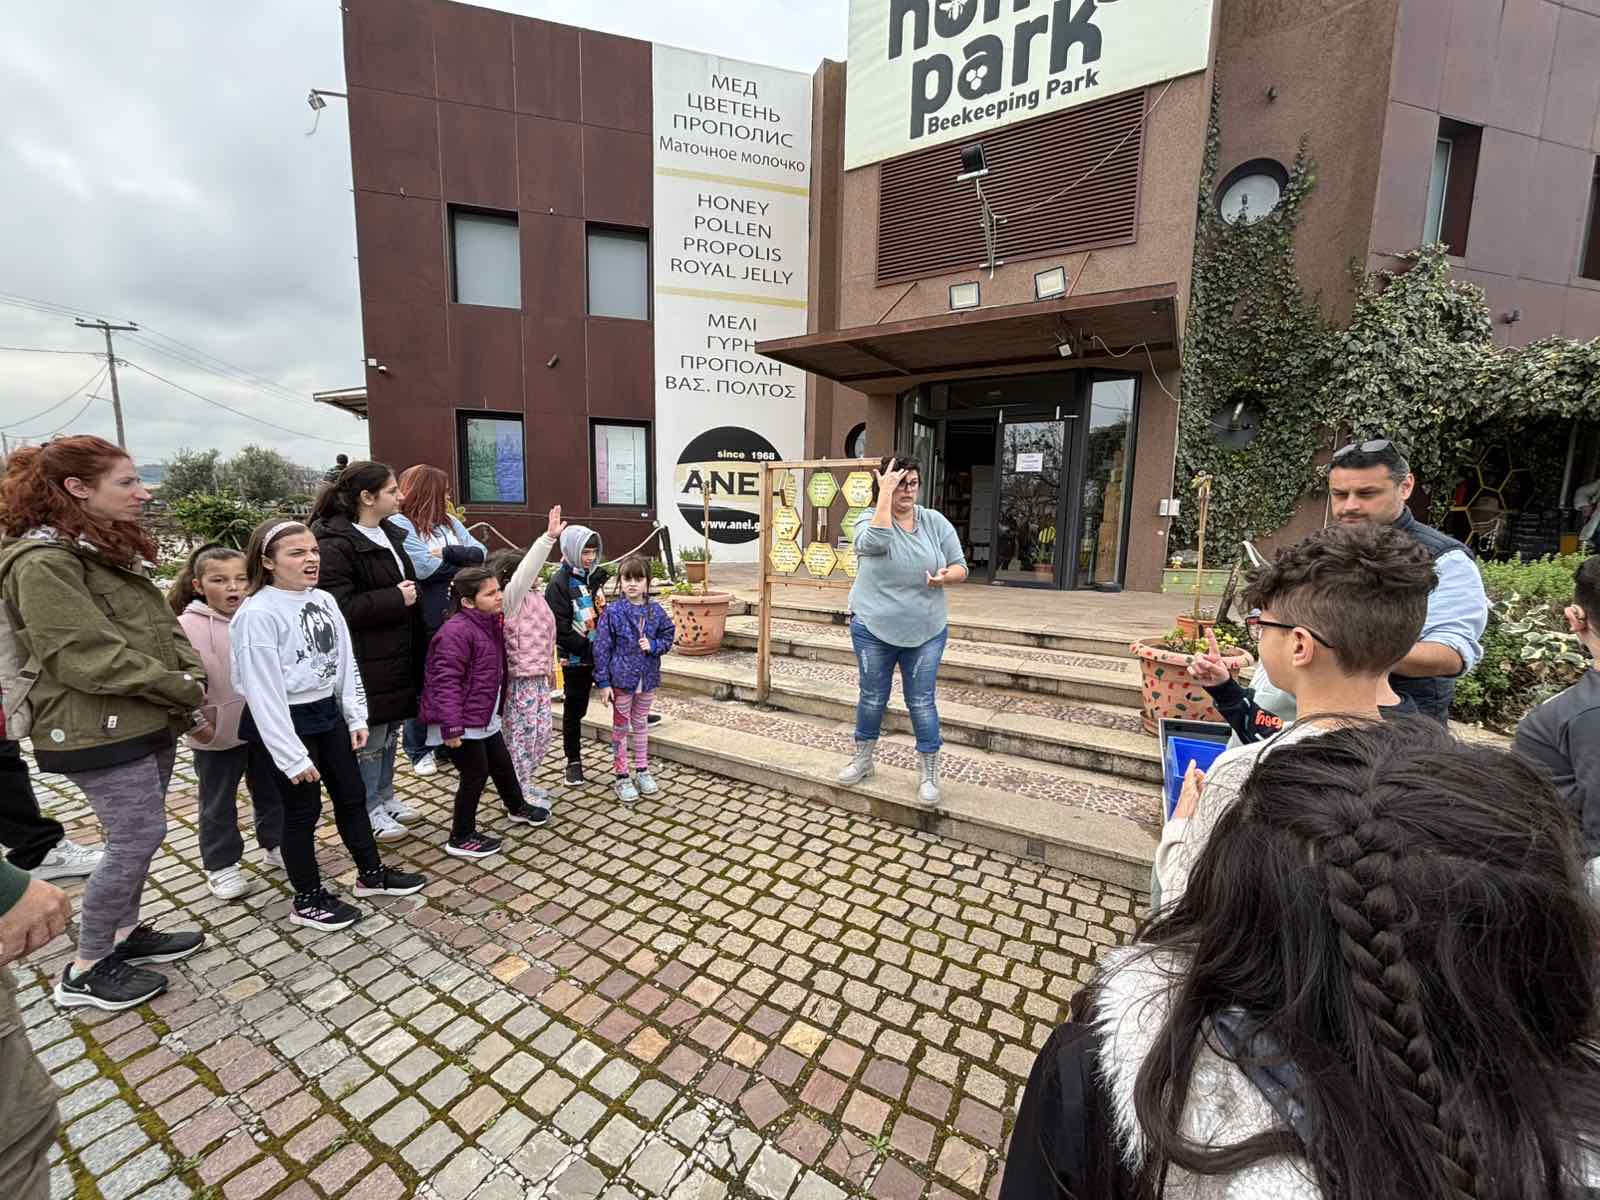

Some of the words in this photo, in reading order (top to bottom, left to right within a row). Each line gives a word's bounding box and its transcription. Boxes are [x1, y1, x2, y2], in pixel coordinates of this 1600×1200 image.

[909, 0, 1102, 139] park
[711, 74, 758, 99] МЕД
[687, 93, 781, 122] ЦВЕТЕНЬ
[927, 88, 1039, 135] Beekeeping
[1046, 67, 1099, 100] Park
[673, 114, 793, 148] ПРОПОЛИС
[659, 136, 737, 160] Маточное
[741, 152, 805, 172] молочко
[698, 193, 770, 216] HONEY
[694, 216, 772, 239] POLLEN
[683, 237, 782, 262] PROPOLIS
[671, 258, 736, 278] ROYAL
[741, 266, 793, 284] JELLY
[707, 313, 757, 332] ΜΕΛΙ
[680, 355, 782, 377] ΠΡΟΠΟΛΗ
[665, 376, 710, 393] ΒΑΣ.
[716, 380, 797, 399] ΠΟΛΤΟΣ
[717, 450, 745, 459] since
[751, 451, 775, 460] 1968
[681, 470, 780, 496] ANE
[700, 519, 760, 532] www.anel.g
